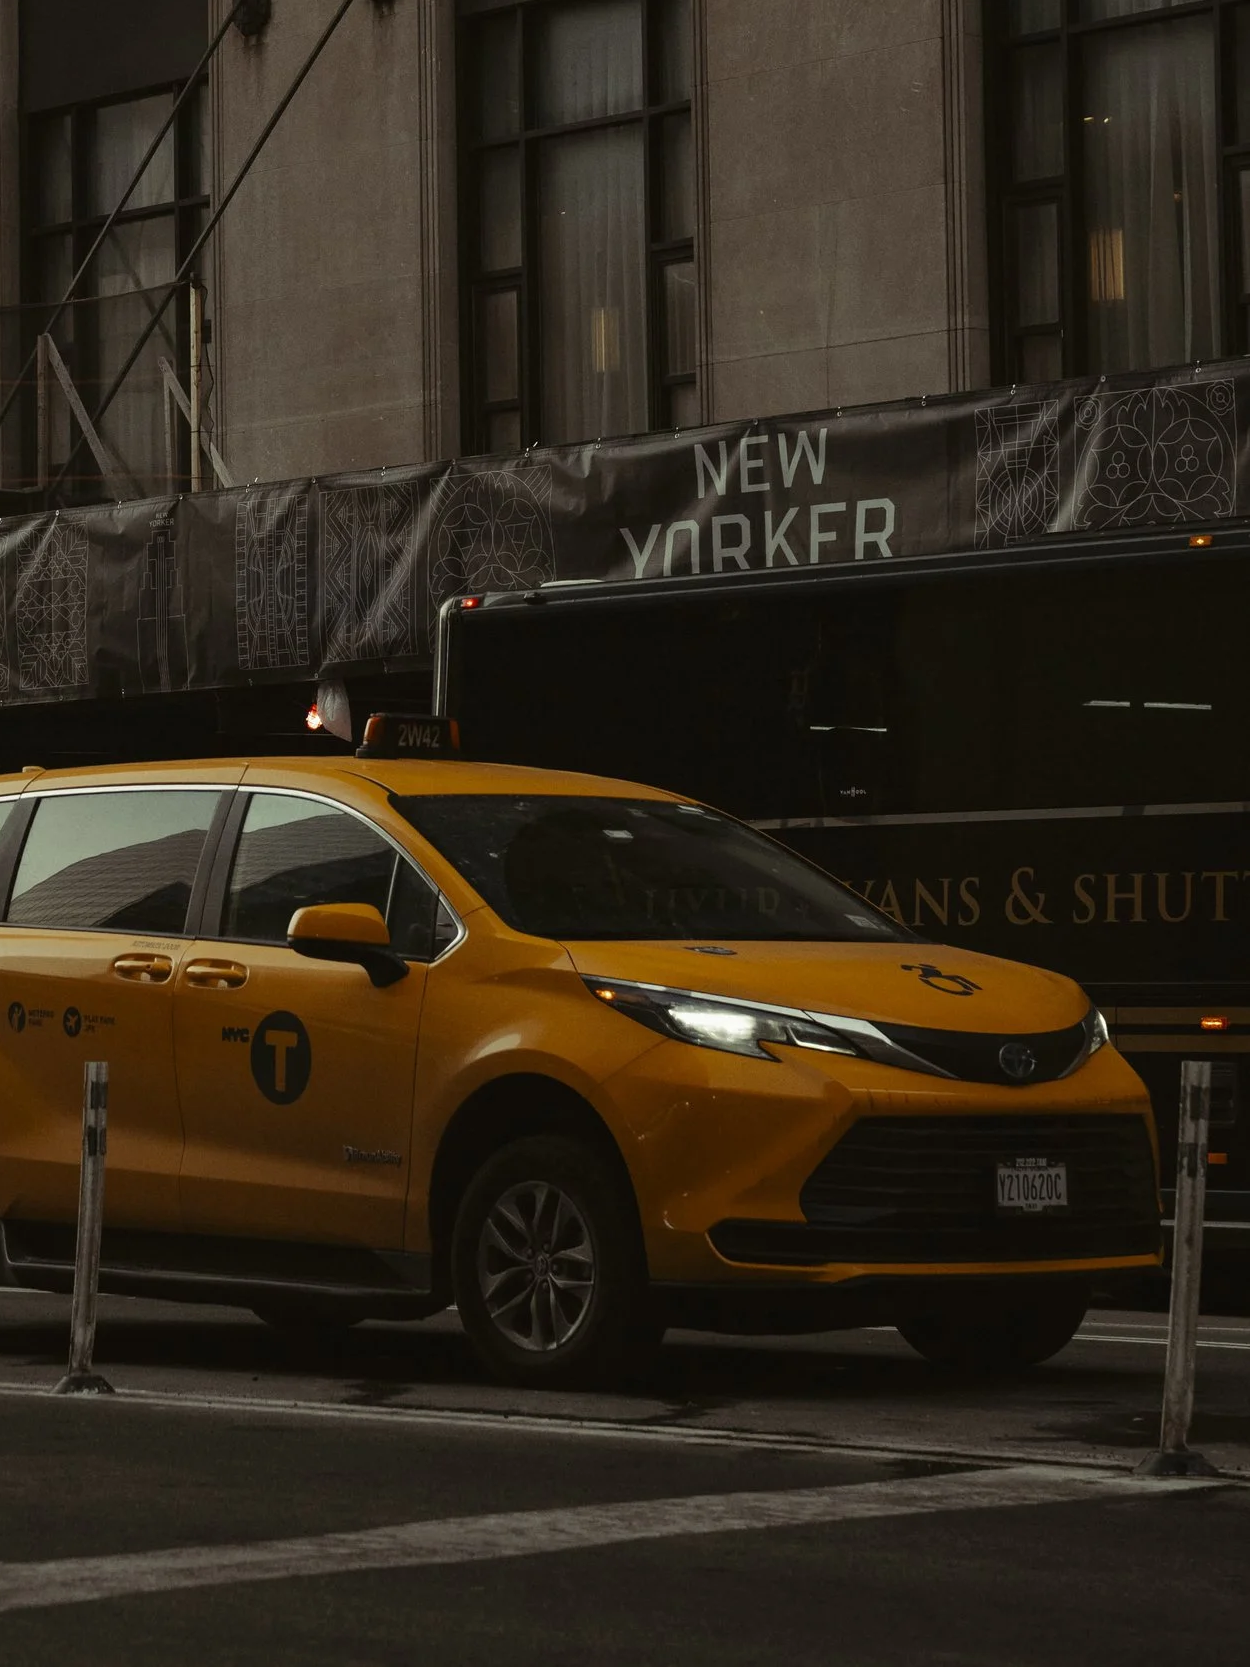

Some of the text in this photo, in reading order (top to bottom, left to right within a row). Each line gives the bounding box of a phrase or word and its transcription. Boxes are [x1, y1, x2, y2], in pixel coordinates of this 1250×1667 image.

[694, 428, 828, 499] NEW
[398, 723, 441, 748] 2W42
[1005, 866, 1055, 925] &
[1073, 870, 1250, 924] SHUT
[222, 1026, 250, 1042] NYC
[999, 1173, 1062, 1201] Y210620C
